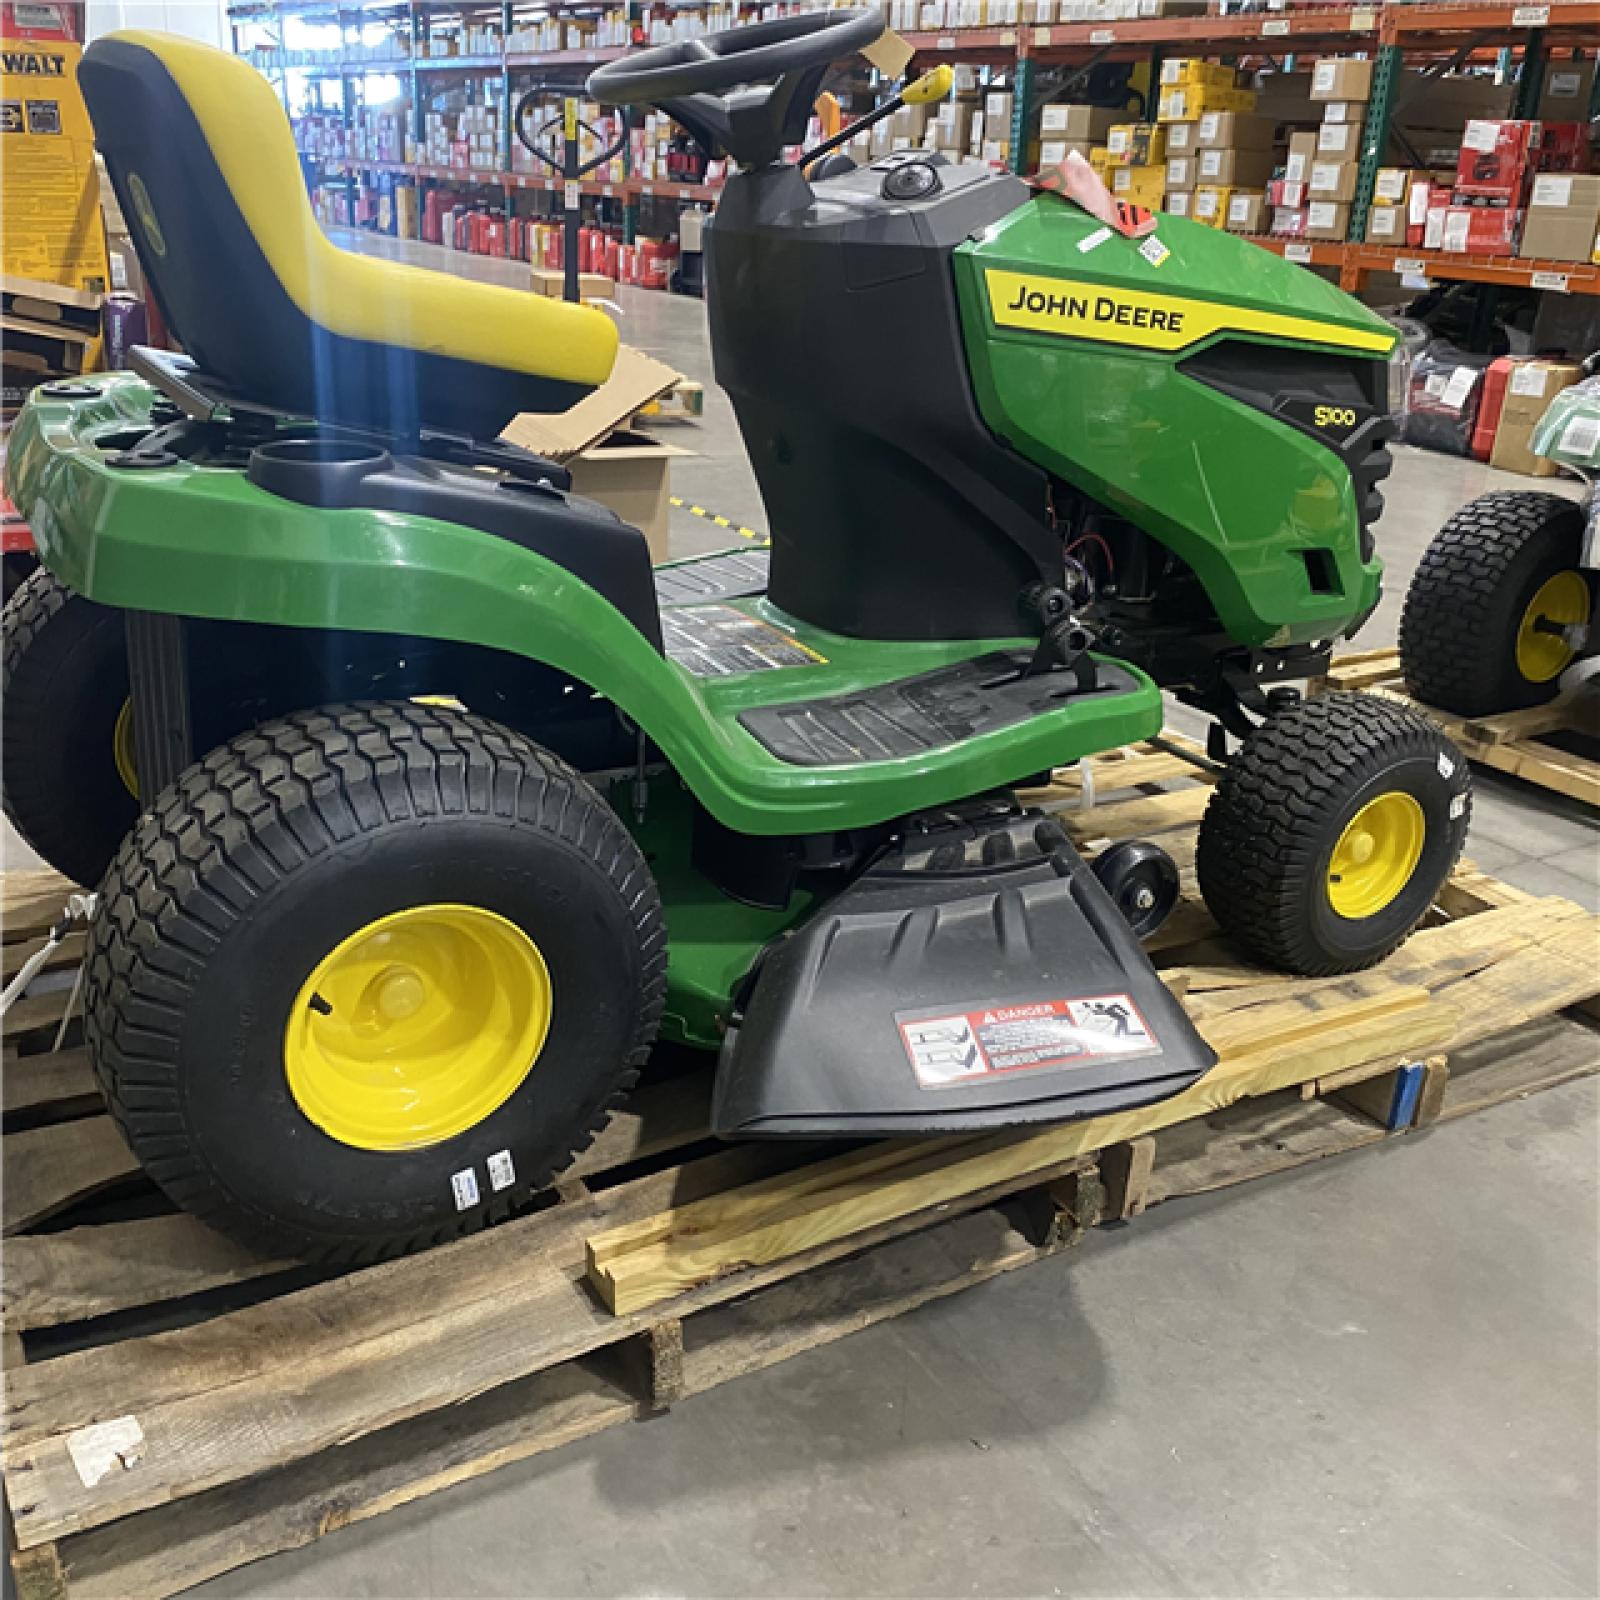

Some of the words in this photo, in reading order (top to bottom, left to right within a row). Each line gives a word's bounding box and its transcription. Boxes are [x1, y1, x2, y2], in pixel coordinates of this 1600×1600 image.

[1008, 285, 1088, 319] JOHN
[1095, 297, 1184, 333] DEERE
[1314, 405, 1356, 426] S100
